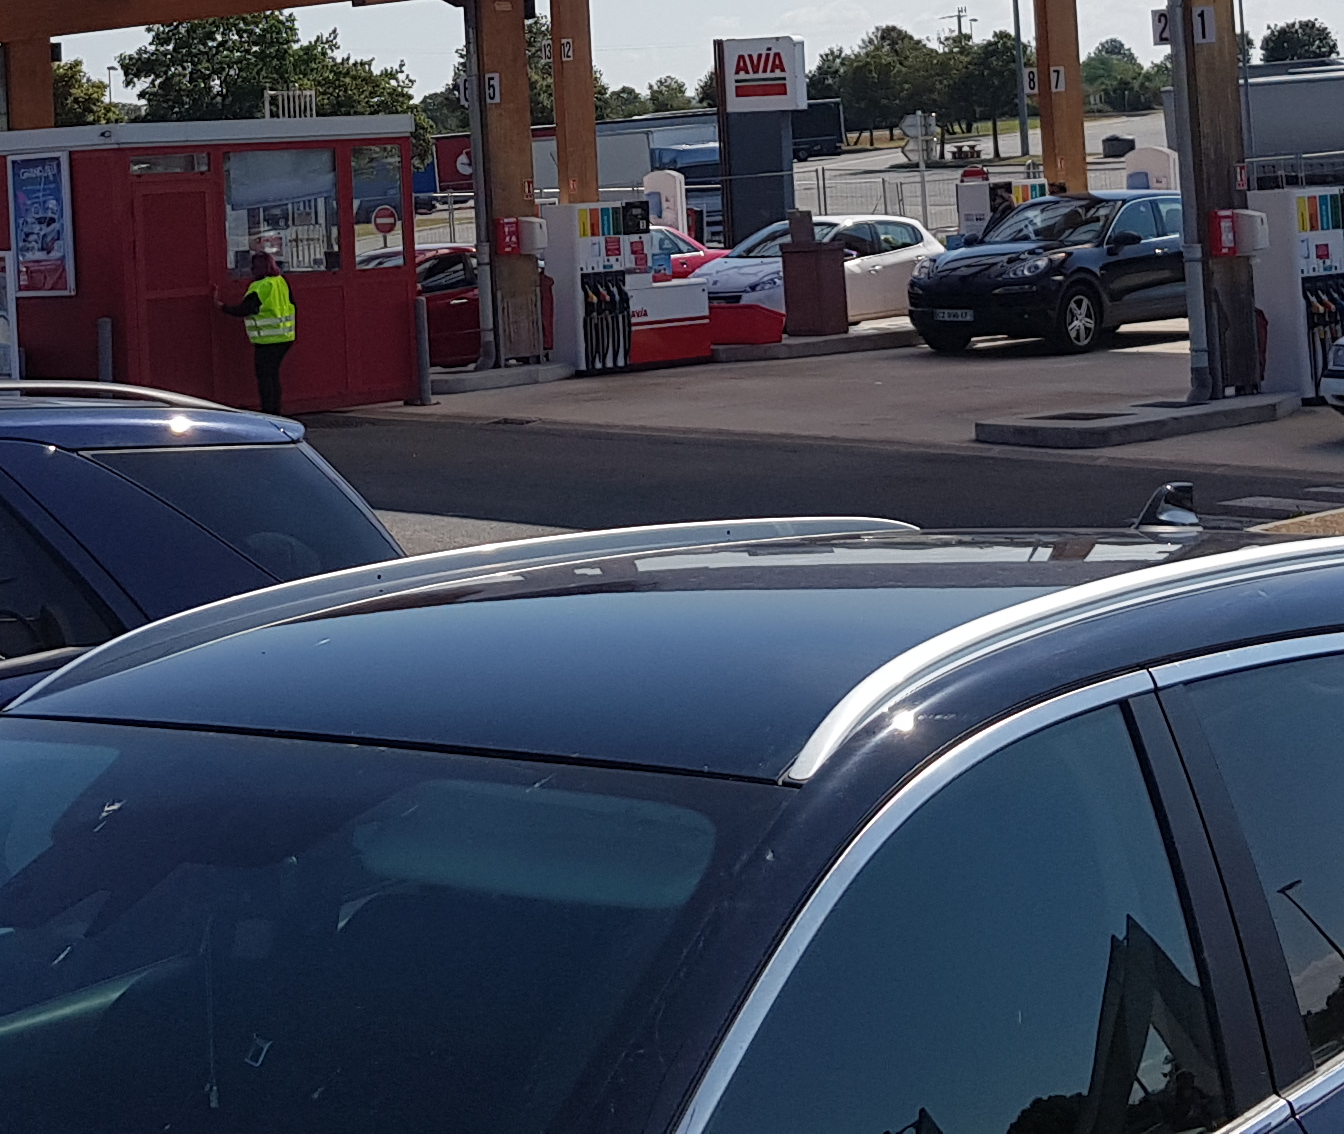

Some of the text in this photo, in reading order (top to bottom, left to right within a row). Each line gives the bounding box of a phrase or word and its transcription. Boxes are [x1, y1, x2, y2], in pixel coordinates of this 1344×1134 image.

[1157, 13, 1170, 41] 2
[1197, 9, 1207, 40] 1
[543, 43, 552, 60] 13
[561, 41, 572, 59] 12
[487, 76, 496, 101] 5
[1027, 70, 1036, 91] 8
[1052, 69, 1061, 90] 7
